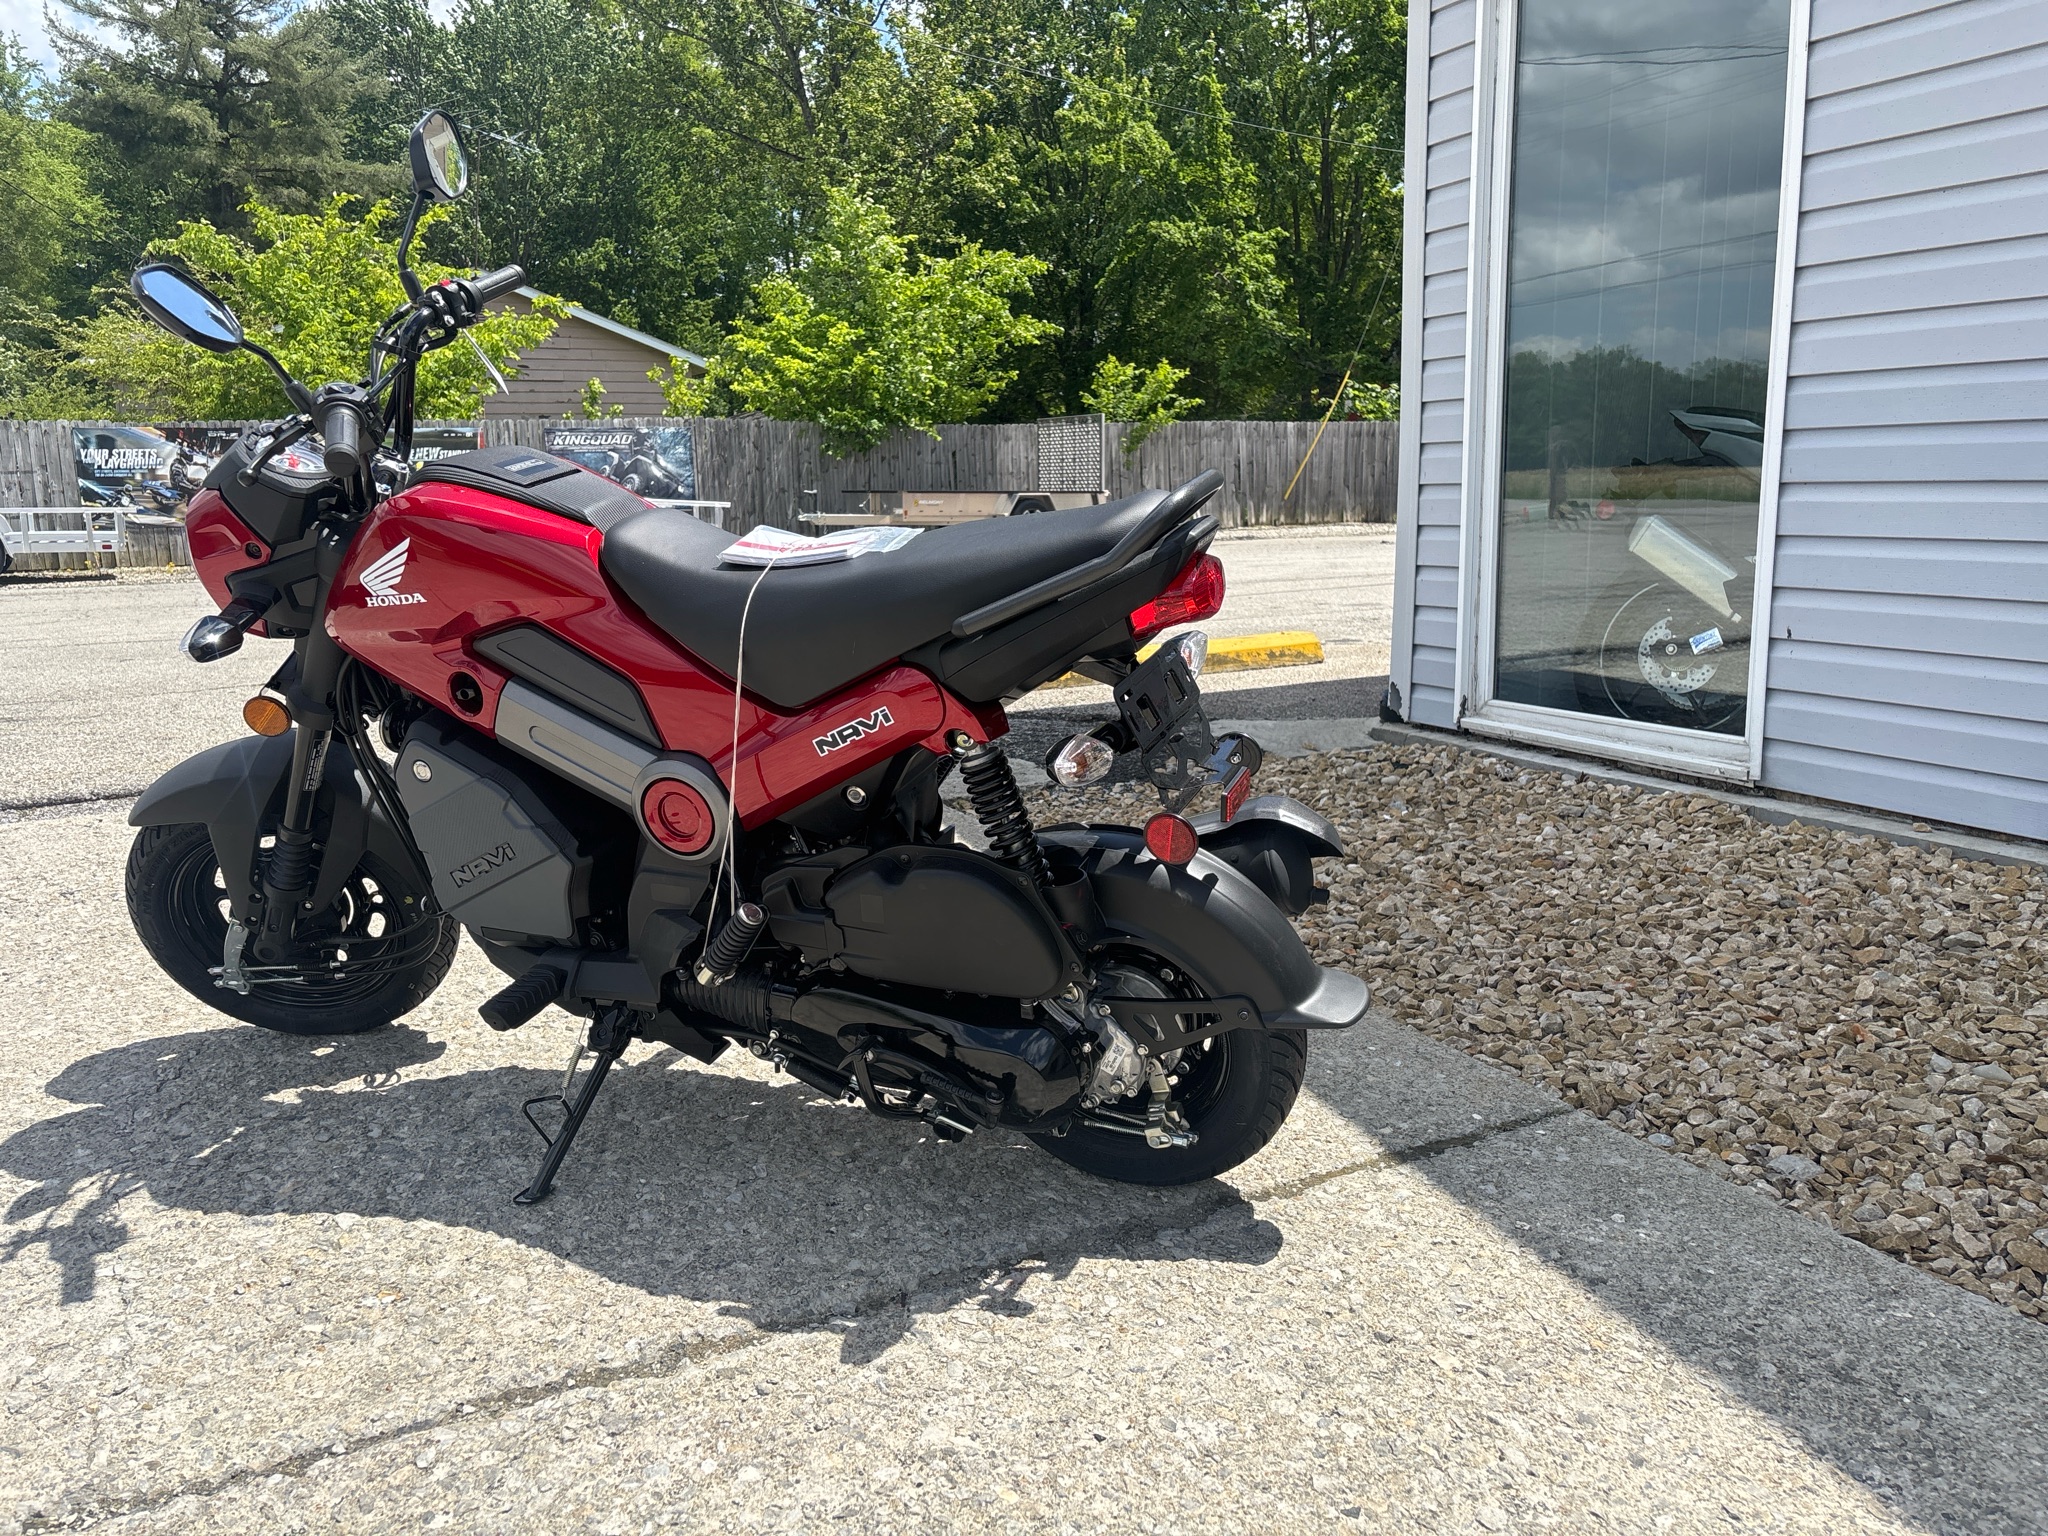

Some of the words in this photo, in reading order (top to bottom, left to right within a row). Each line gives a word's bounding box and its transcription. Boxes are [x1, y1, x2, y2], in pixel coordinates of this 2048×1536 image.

[553, 434, 633, 446] KINGQUAD
[79, 448, 109, 460] YOUR
[111, 448, 158, 460] STREETS
[415, 447, 442, 460] NEW
[94, 457, 164, 469] PLAYGROUND
[364, 592, 428, 608] HONDA
